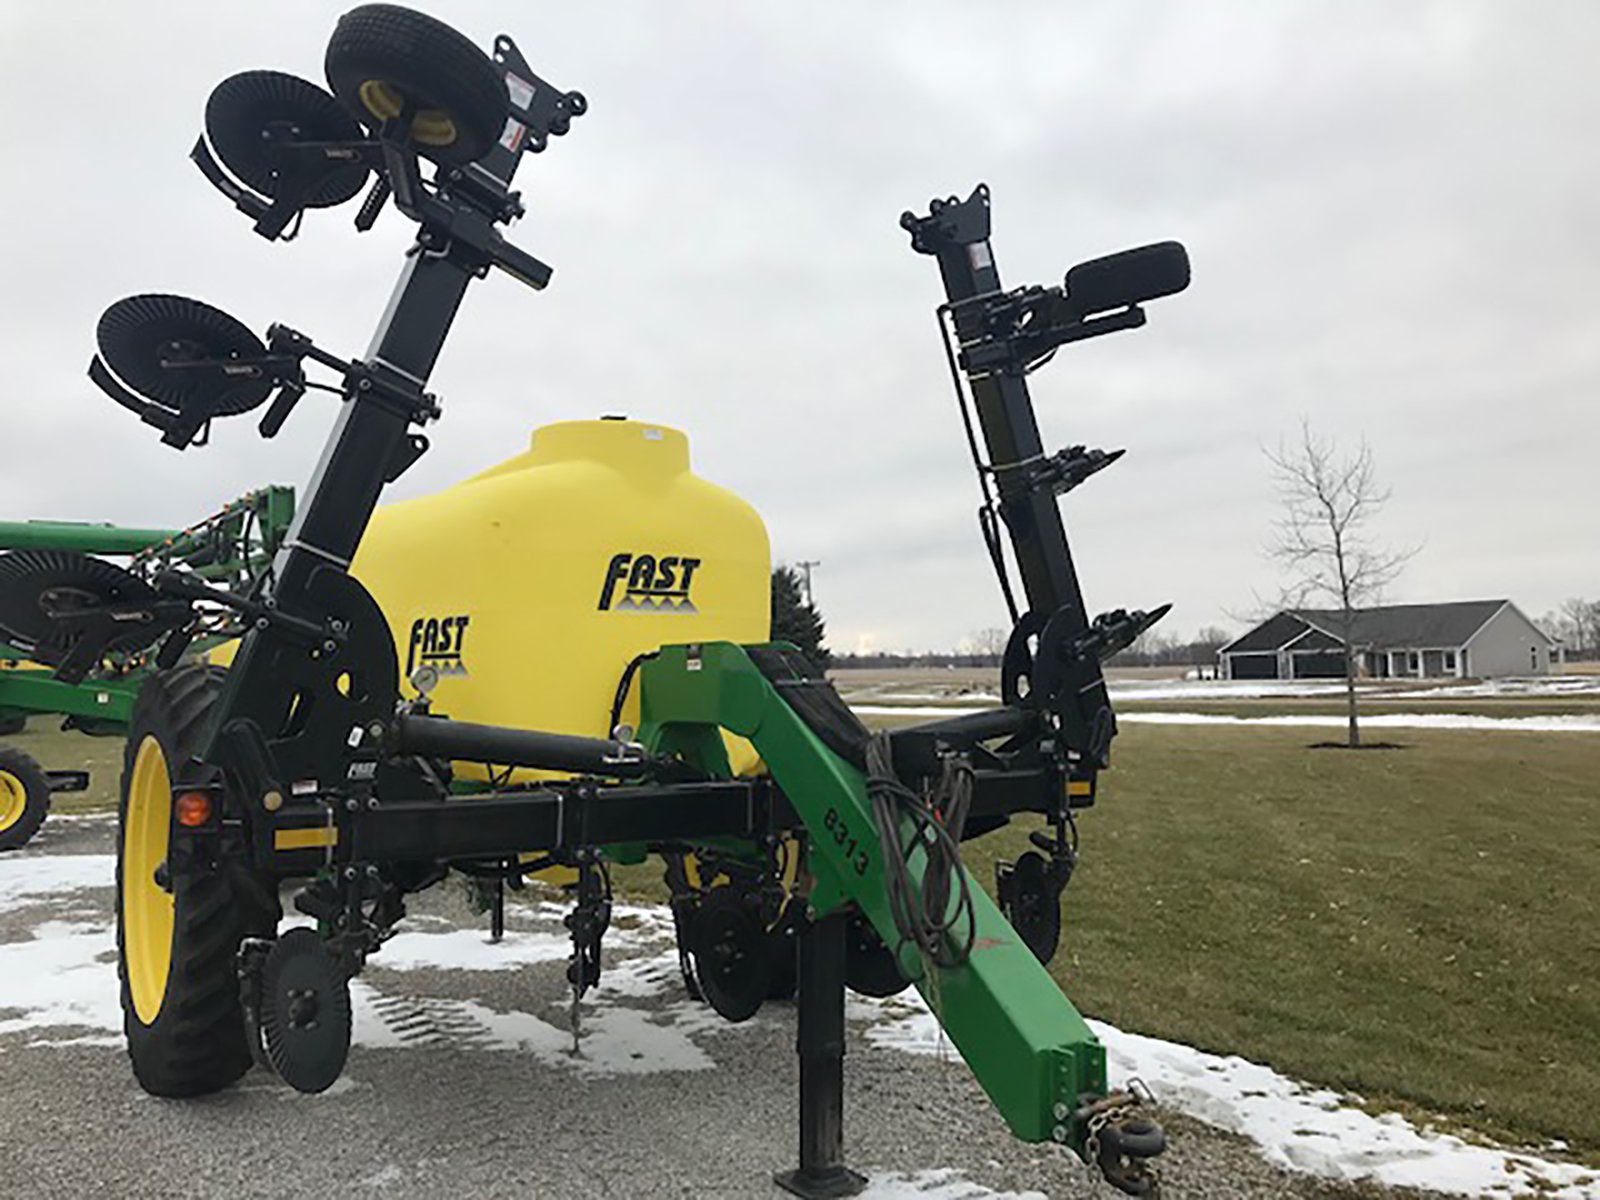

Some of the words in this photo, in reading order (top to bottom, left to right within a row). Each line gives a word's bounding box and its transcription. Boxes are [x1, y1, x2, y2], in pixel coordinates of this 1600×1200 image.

[598, 553, 701, 611] FAST
[405, 616, 470, 678] FAST
[824, 807, 869, 876] 8313
